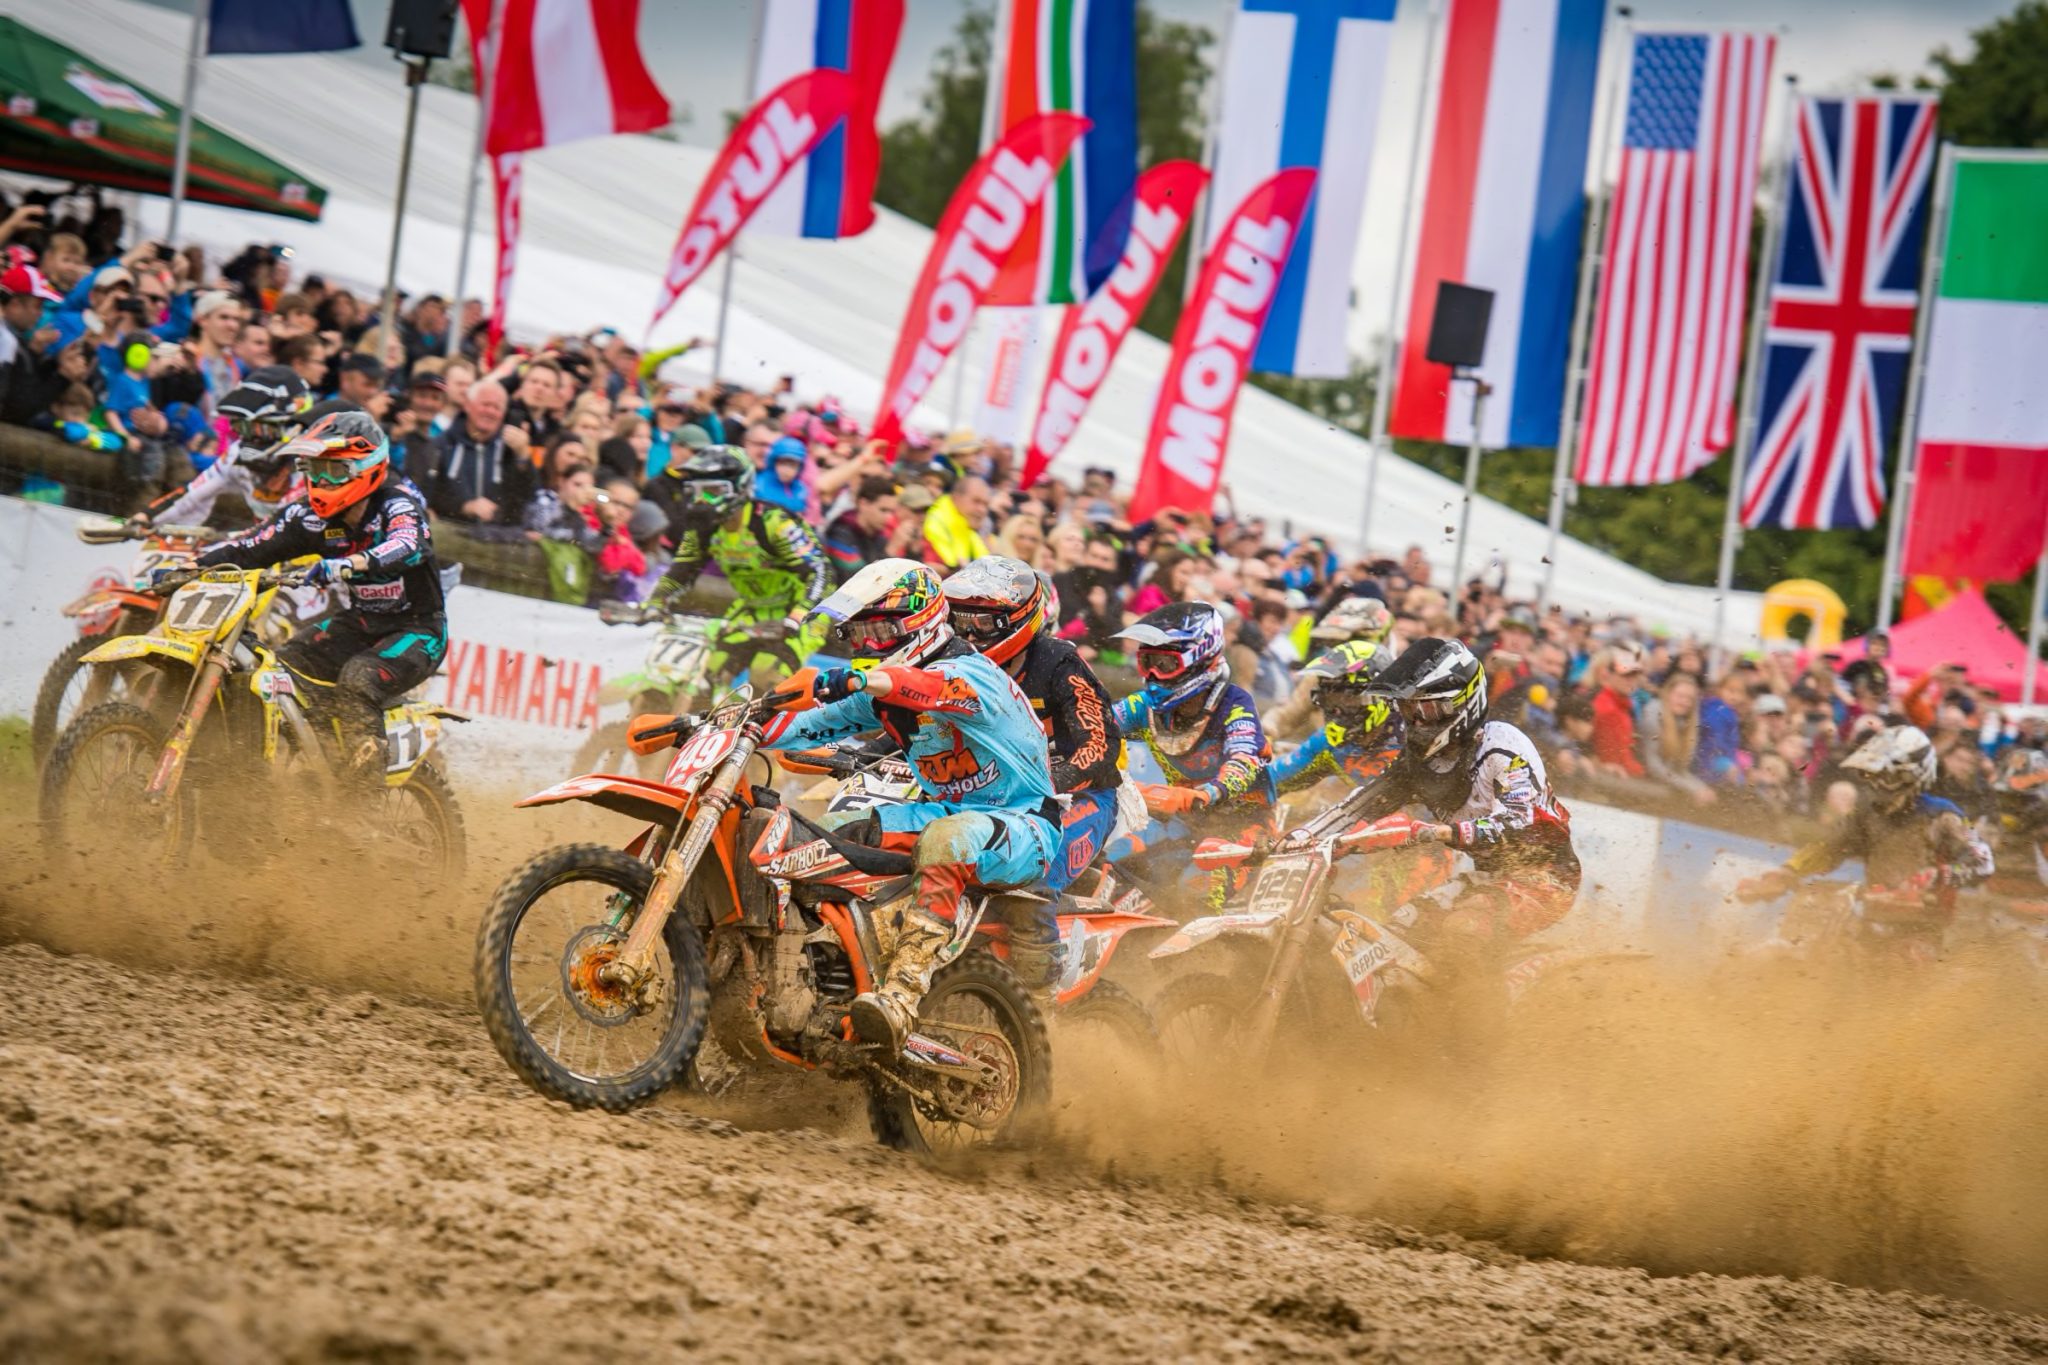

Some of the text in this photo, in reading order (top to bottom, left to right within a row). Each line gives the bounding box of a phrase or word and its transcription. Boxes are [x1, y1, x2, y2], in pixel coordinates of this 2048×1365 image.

[1159, 215, 1291, 491] MOTUL
[172, 592, 236, 625] 11
[446, 638, 601, 731] YAMAHA
[900, 686, 932, 704] SCOTT
[668, 732, 728, 779] 149
[914, 748, 981, 784] KTM
[768, 843, 830, 875] SARHOLZ
[1351, 941, 1391, 978] REPSOL
